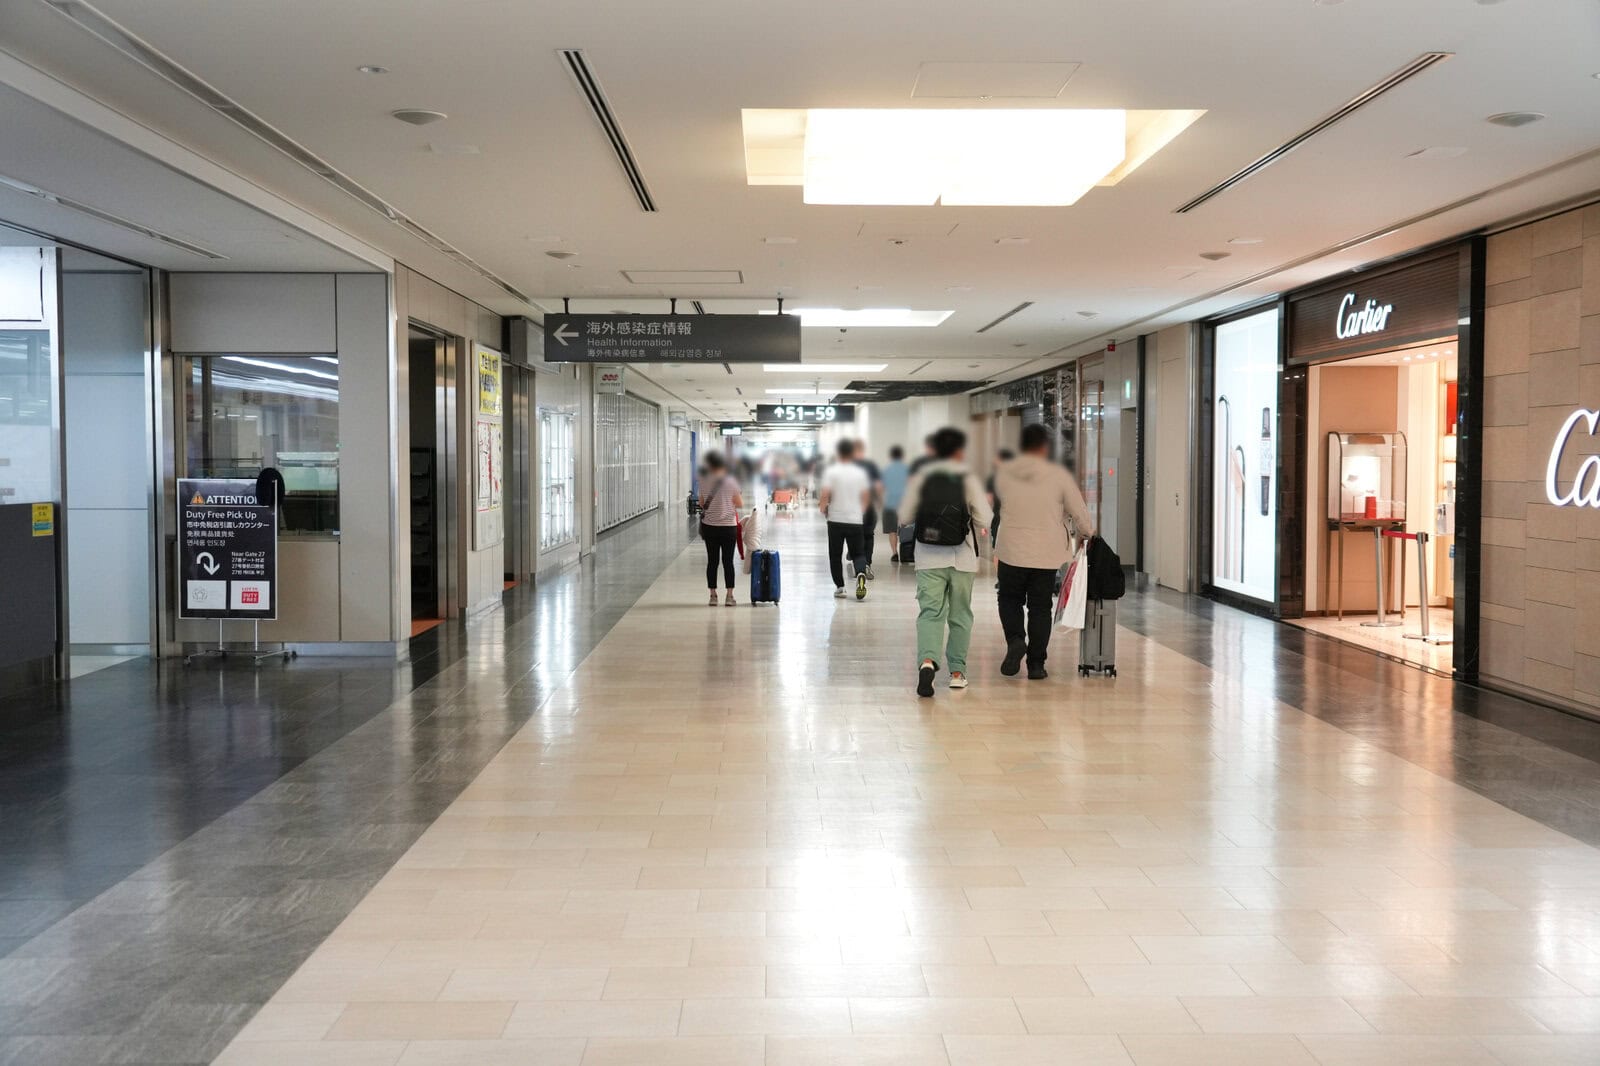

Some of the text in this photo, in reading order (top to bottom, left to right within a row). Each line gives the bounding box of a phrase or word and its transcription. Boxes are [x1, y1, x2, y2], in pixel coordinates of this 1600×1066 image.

[1336, 293, 1392, 339] Cartier
[586, 321, 692, 335] 海外感染症情報
[587, 338, 672, 346] Health Information
[206, 495, 258, 504] ATTENTIO
[186, 511, 257, 520] Duty Free Pick Up
